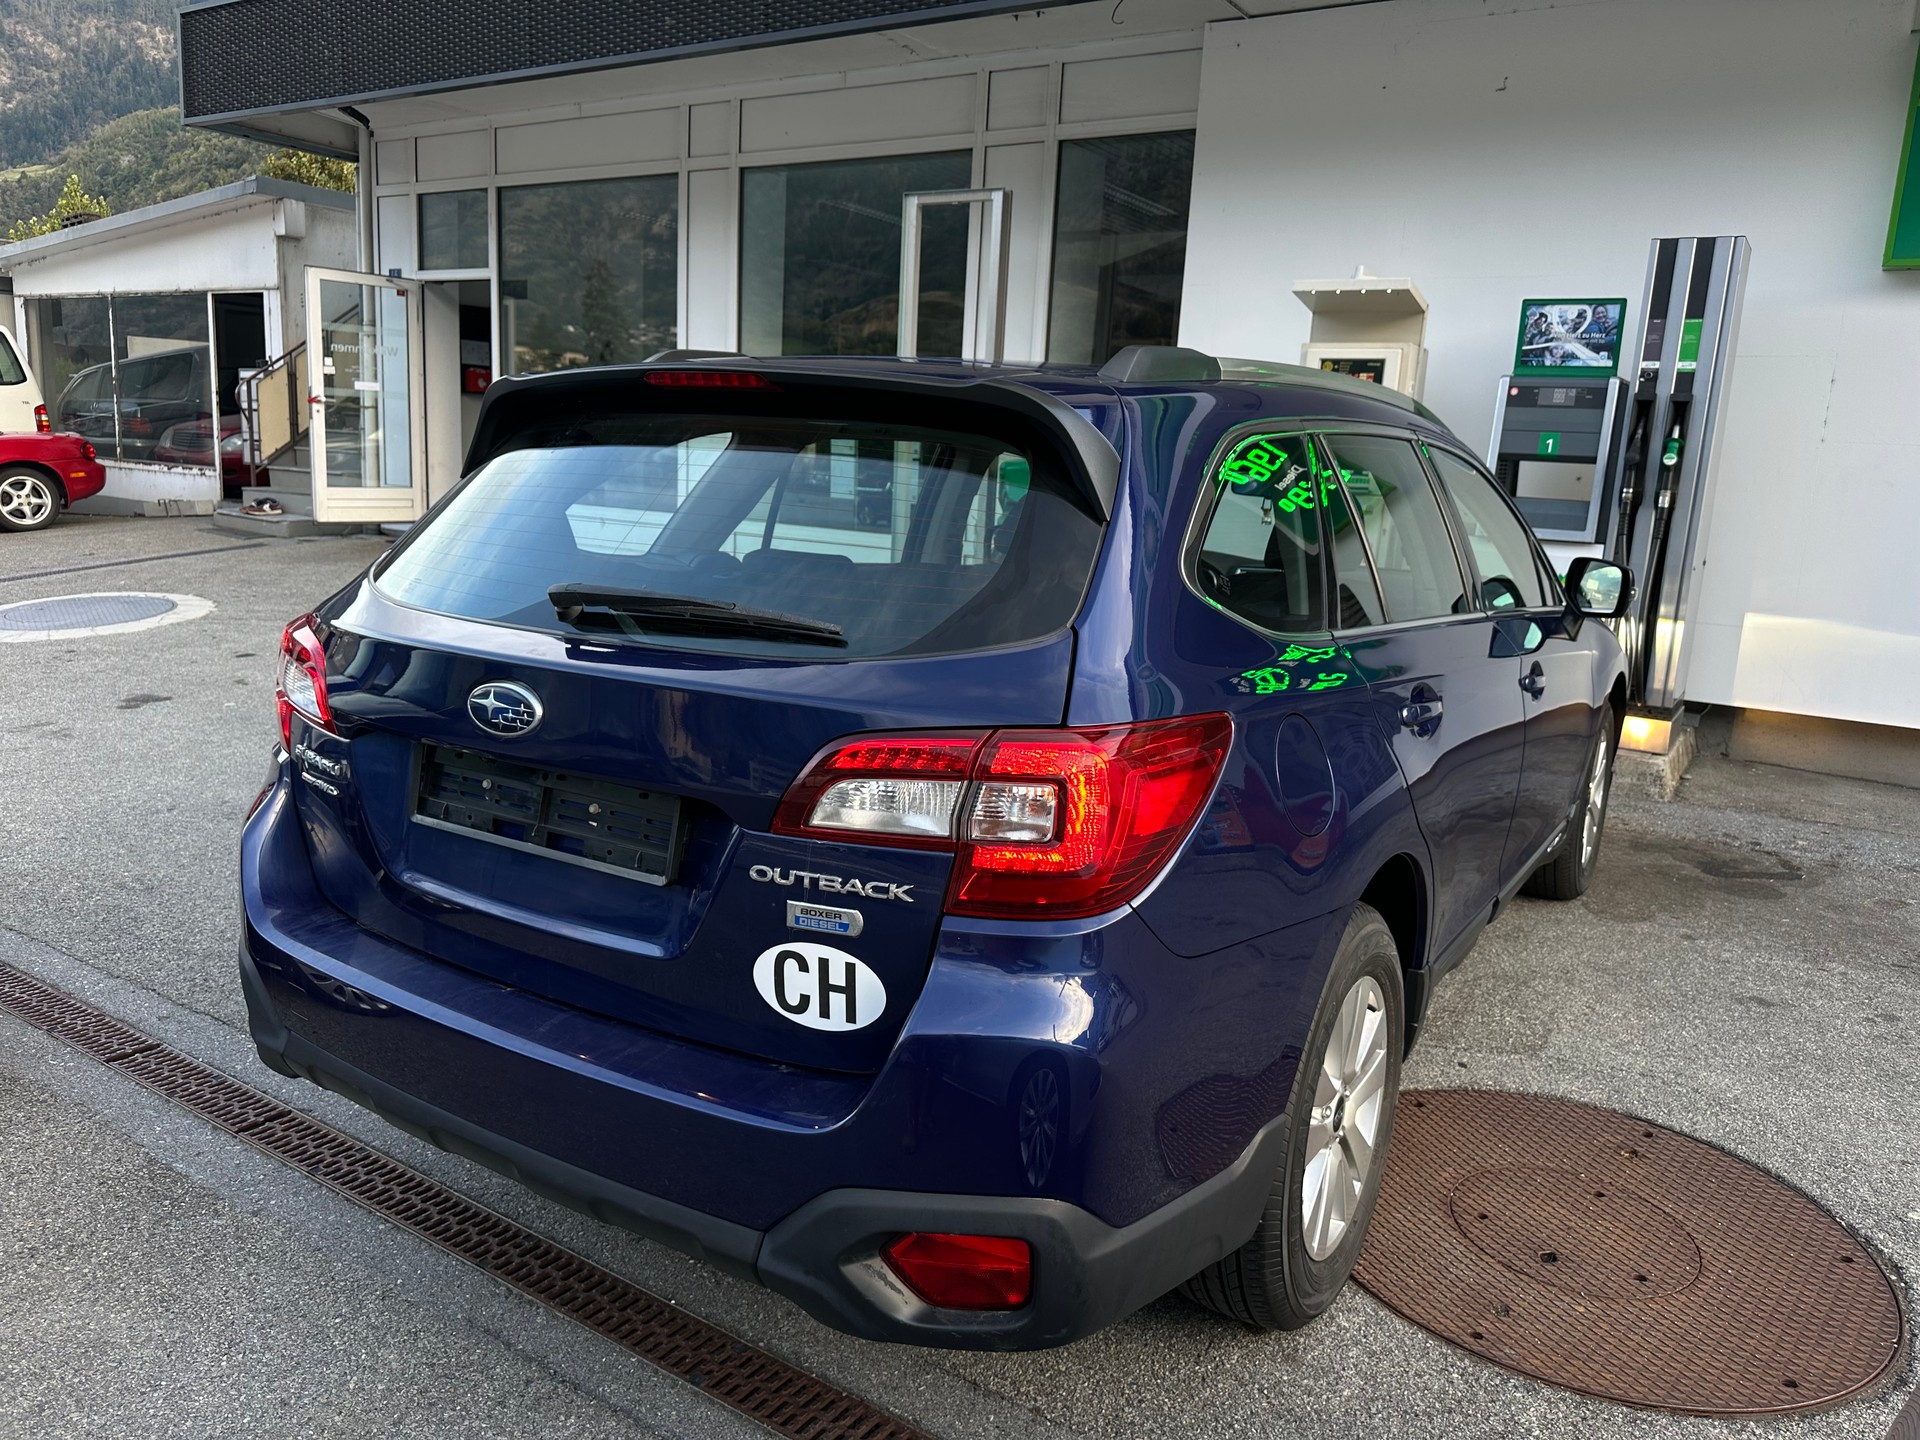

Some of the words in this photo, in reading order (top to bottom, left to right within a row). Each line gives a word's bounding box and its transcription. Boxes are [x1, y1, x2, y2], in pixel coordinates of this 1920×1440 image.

[1546, 438, 1553, 453] 1
[749, 864, 915, 903] OUTBACK
[800, 907, 842, 921] BOXER
[799, 917, 844, 932] DIESEL
[773, 949, 857, 1025] CH
